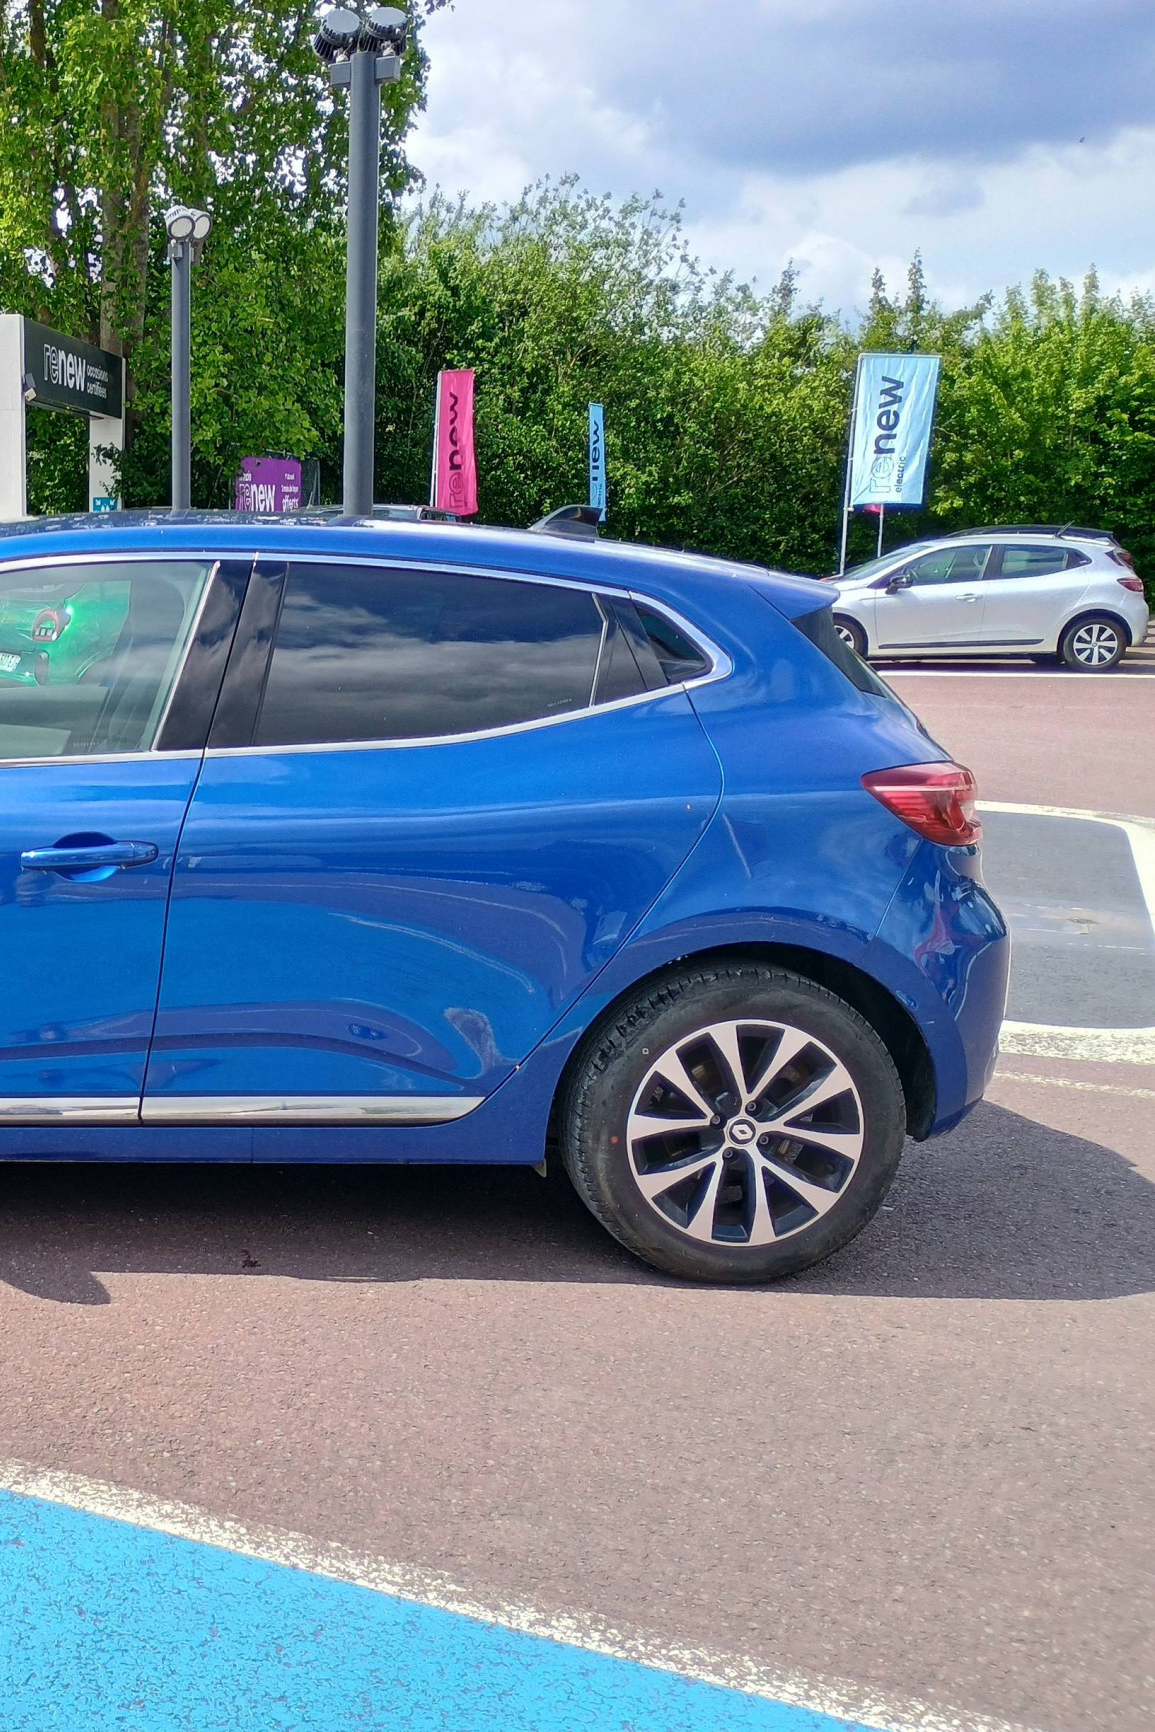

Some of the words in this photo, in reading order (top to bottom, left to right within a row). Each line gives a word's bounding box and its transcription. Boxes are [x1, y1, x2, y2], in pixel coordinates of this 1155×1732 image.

[43, 343, 87, 392] renew
[869, 375, 905, 494] renew
[894, 456, 907, 493] electric
